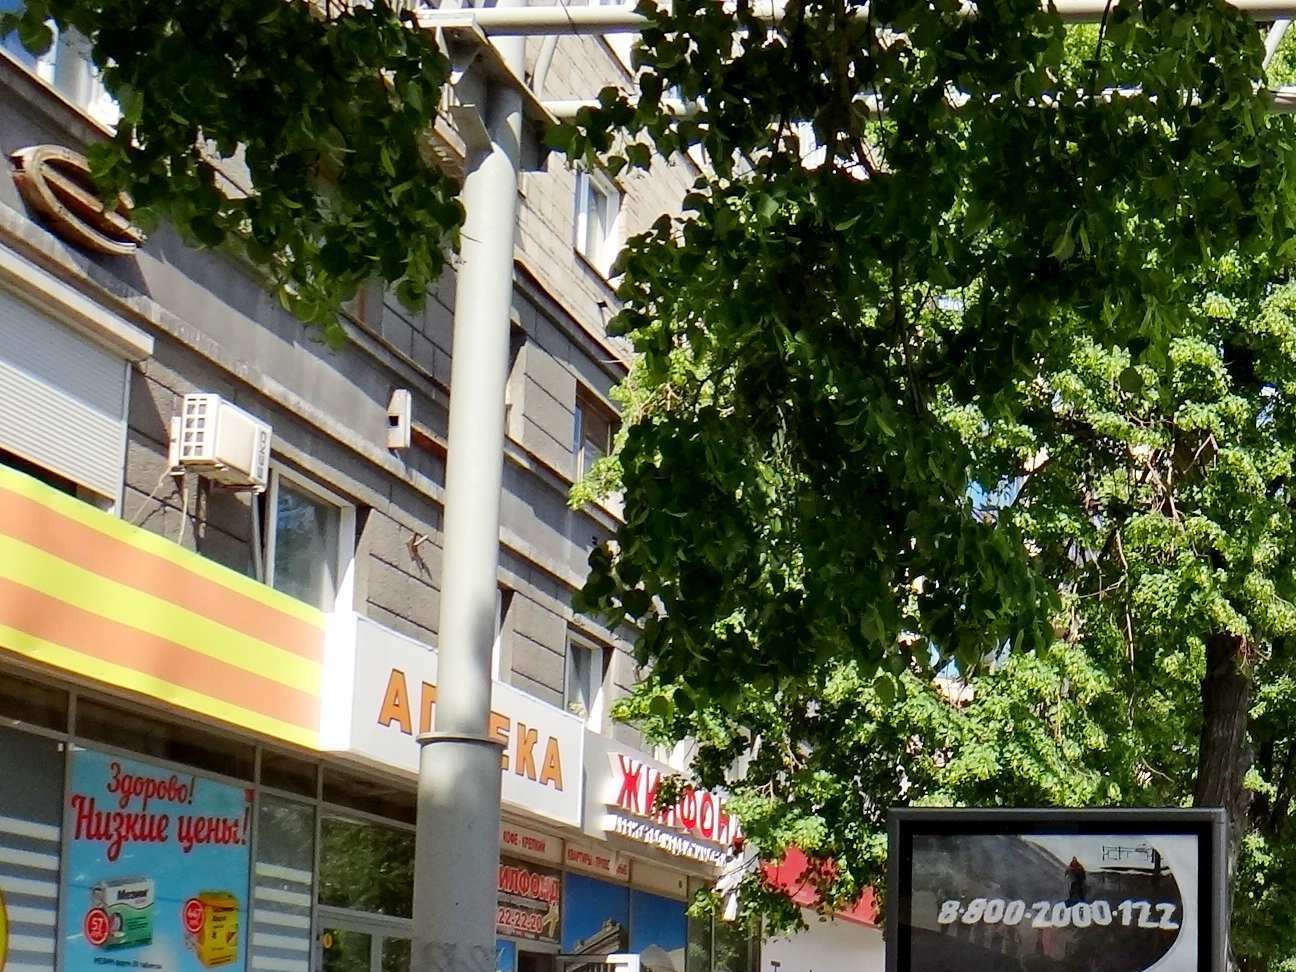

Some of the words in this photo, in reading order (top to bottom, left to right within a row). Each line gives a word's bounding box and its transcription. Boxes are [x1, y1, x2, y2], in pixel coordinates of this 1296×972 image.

[378, 668, 563, 791] АПЕКА
[107, 762, 195, 811] Здорово!
[71, 794, 169, 862] Низкие
[177, 806, 249, 853] цены!
